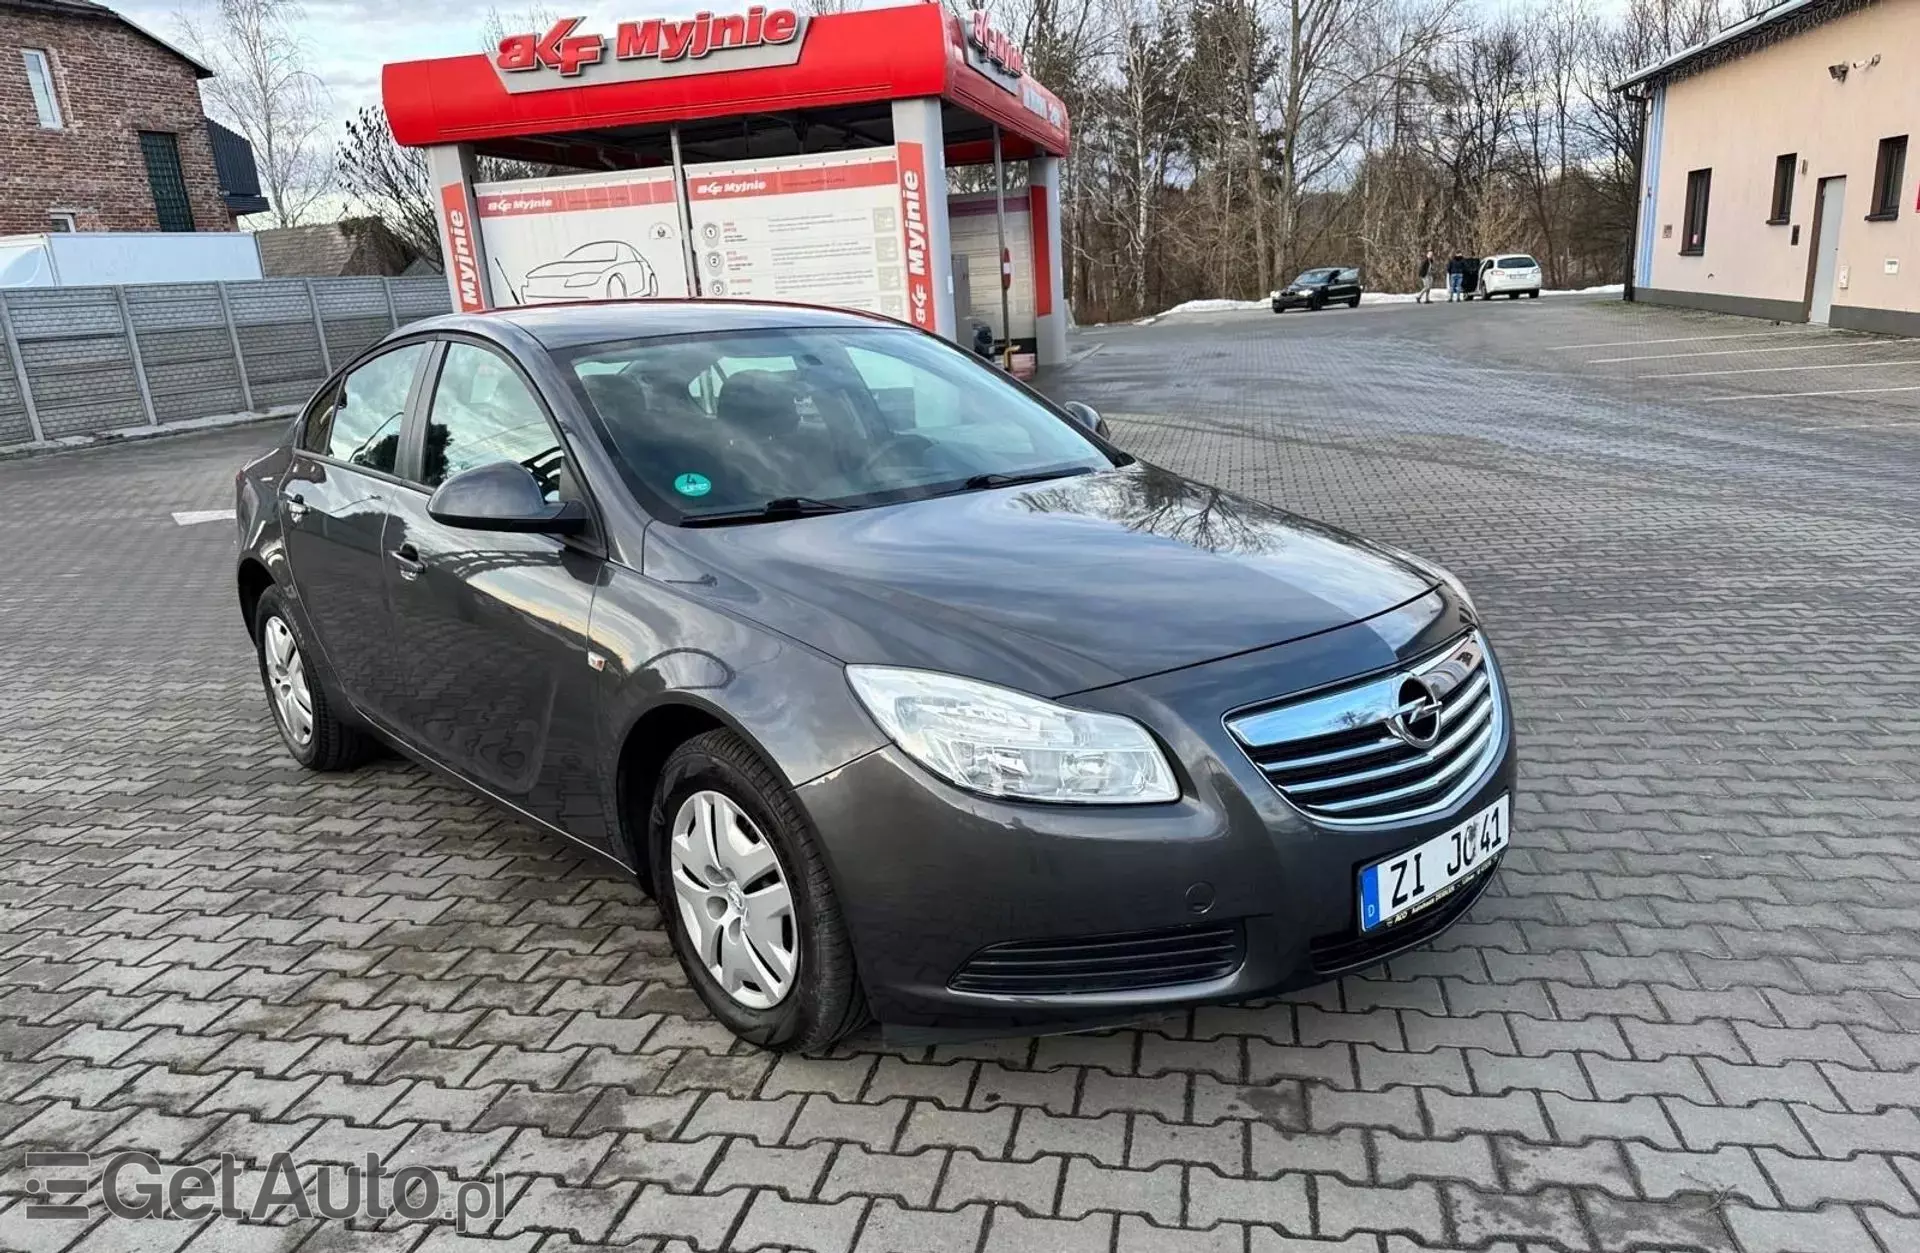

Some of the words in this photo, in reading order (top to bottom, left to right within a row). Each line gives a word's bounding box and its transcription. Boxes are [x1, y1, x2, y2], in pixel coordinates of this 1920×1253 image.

[616, 5, 799, 61] Myjnie
[724, 179, 767, 193] Myjnie
[903, 170, 927, 275] Myjnie
[450, 209, 478, 305] Myjnie
[1390, 852, 1424, 908] ZI
